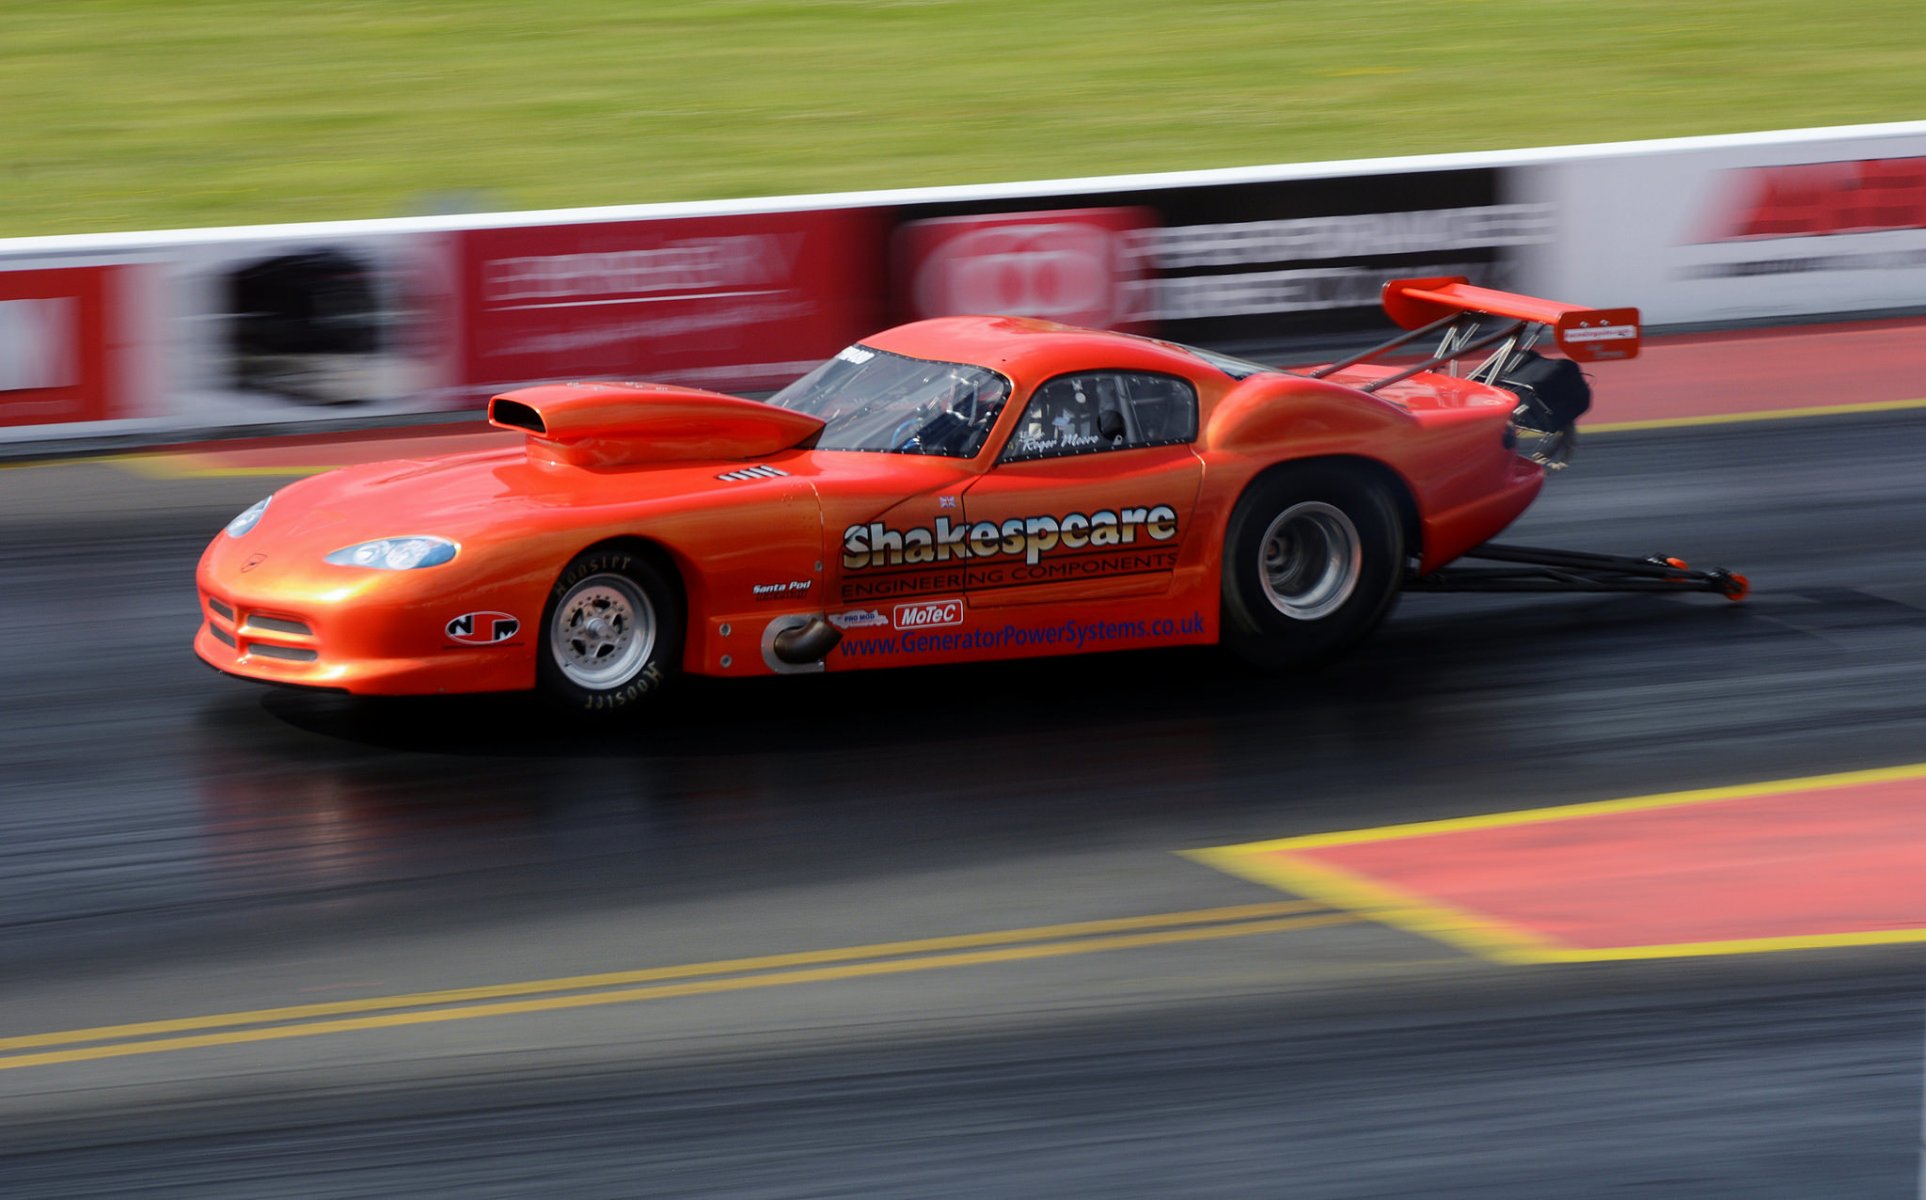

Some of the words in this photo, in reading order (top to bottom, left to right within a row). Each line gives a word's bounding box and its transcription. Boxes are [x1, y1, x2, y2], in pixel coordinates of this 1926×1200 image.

[842, 503, 1178, 569] Shakespeare
[752, 584, 786, 594] Santa
[789, 580, 811, 590] Pod
[841, 567, 1004, 597] ENGINEERING
[1011, 552, 1177, 580] COMPONENTS
[840, 611, 1205, 656] www.GeneratorPowerSystems.co.uk
[902, 603, 956, 625] MoTeC
